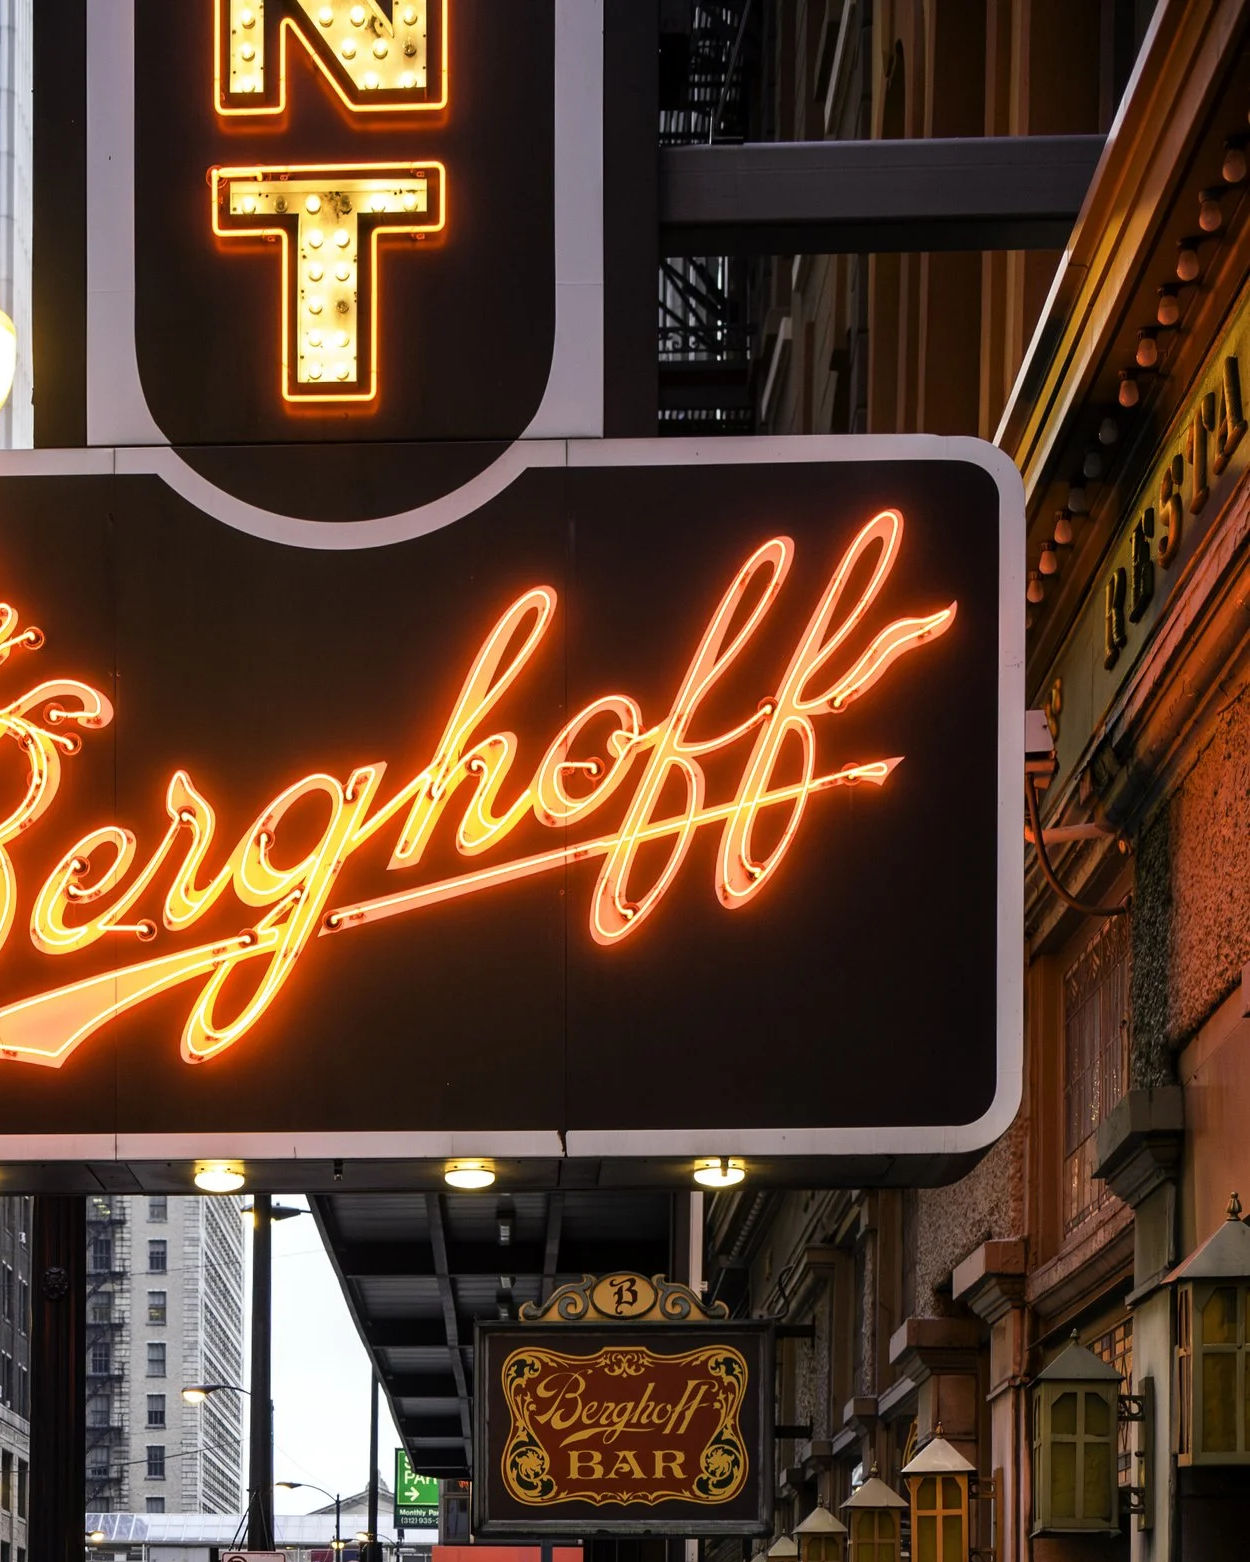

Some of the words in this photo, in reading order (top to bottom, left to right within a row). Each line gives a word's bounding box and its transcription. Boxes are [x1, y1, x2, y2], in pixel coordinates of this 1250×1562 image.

[609, 1277, 639, 1315] B
[534, 1368, 719, 1448] Berghoff
[566, 1450, 689, 1480] BAR
[399, 1508, 426, 1517] Monthly
[401, 1517, 418, 1525] (312)
